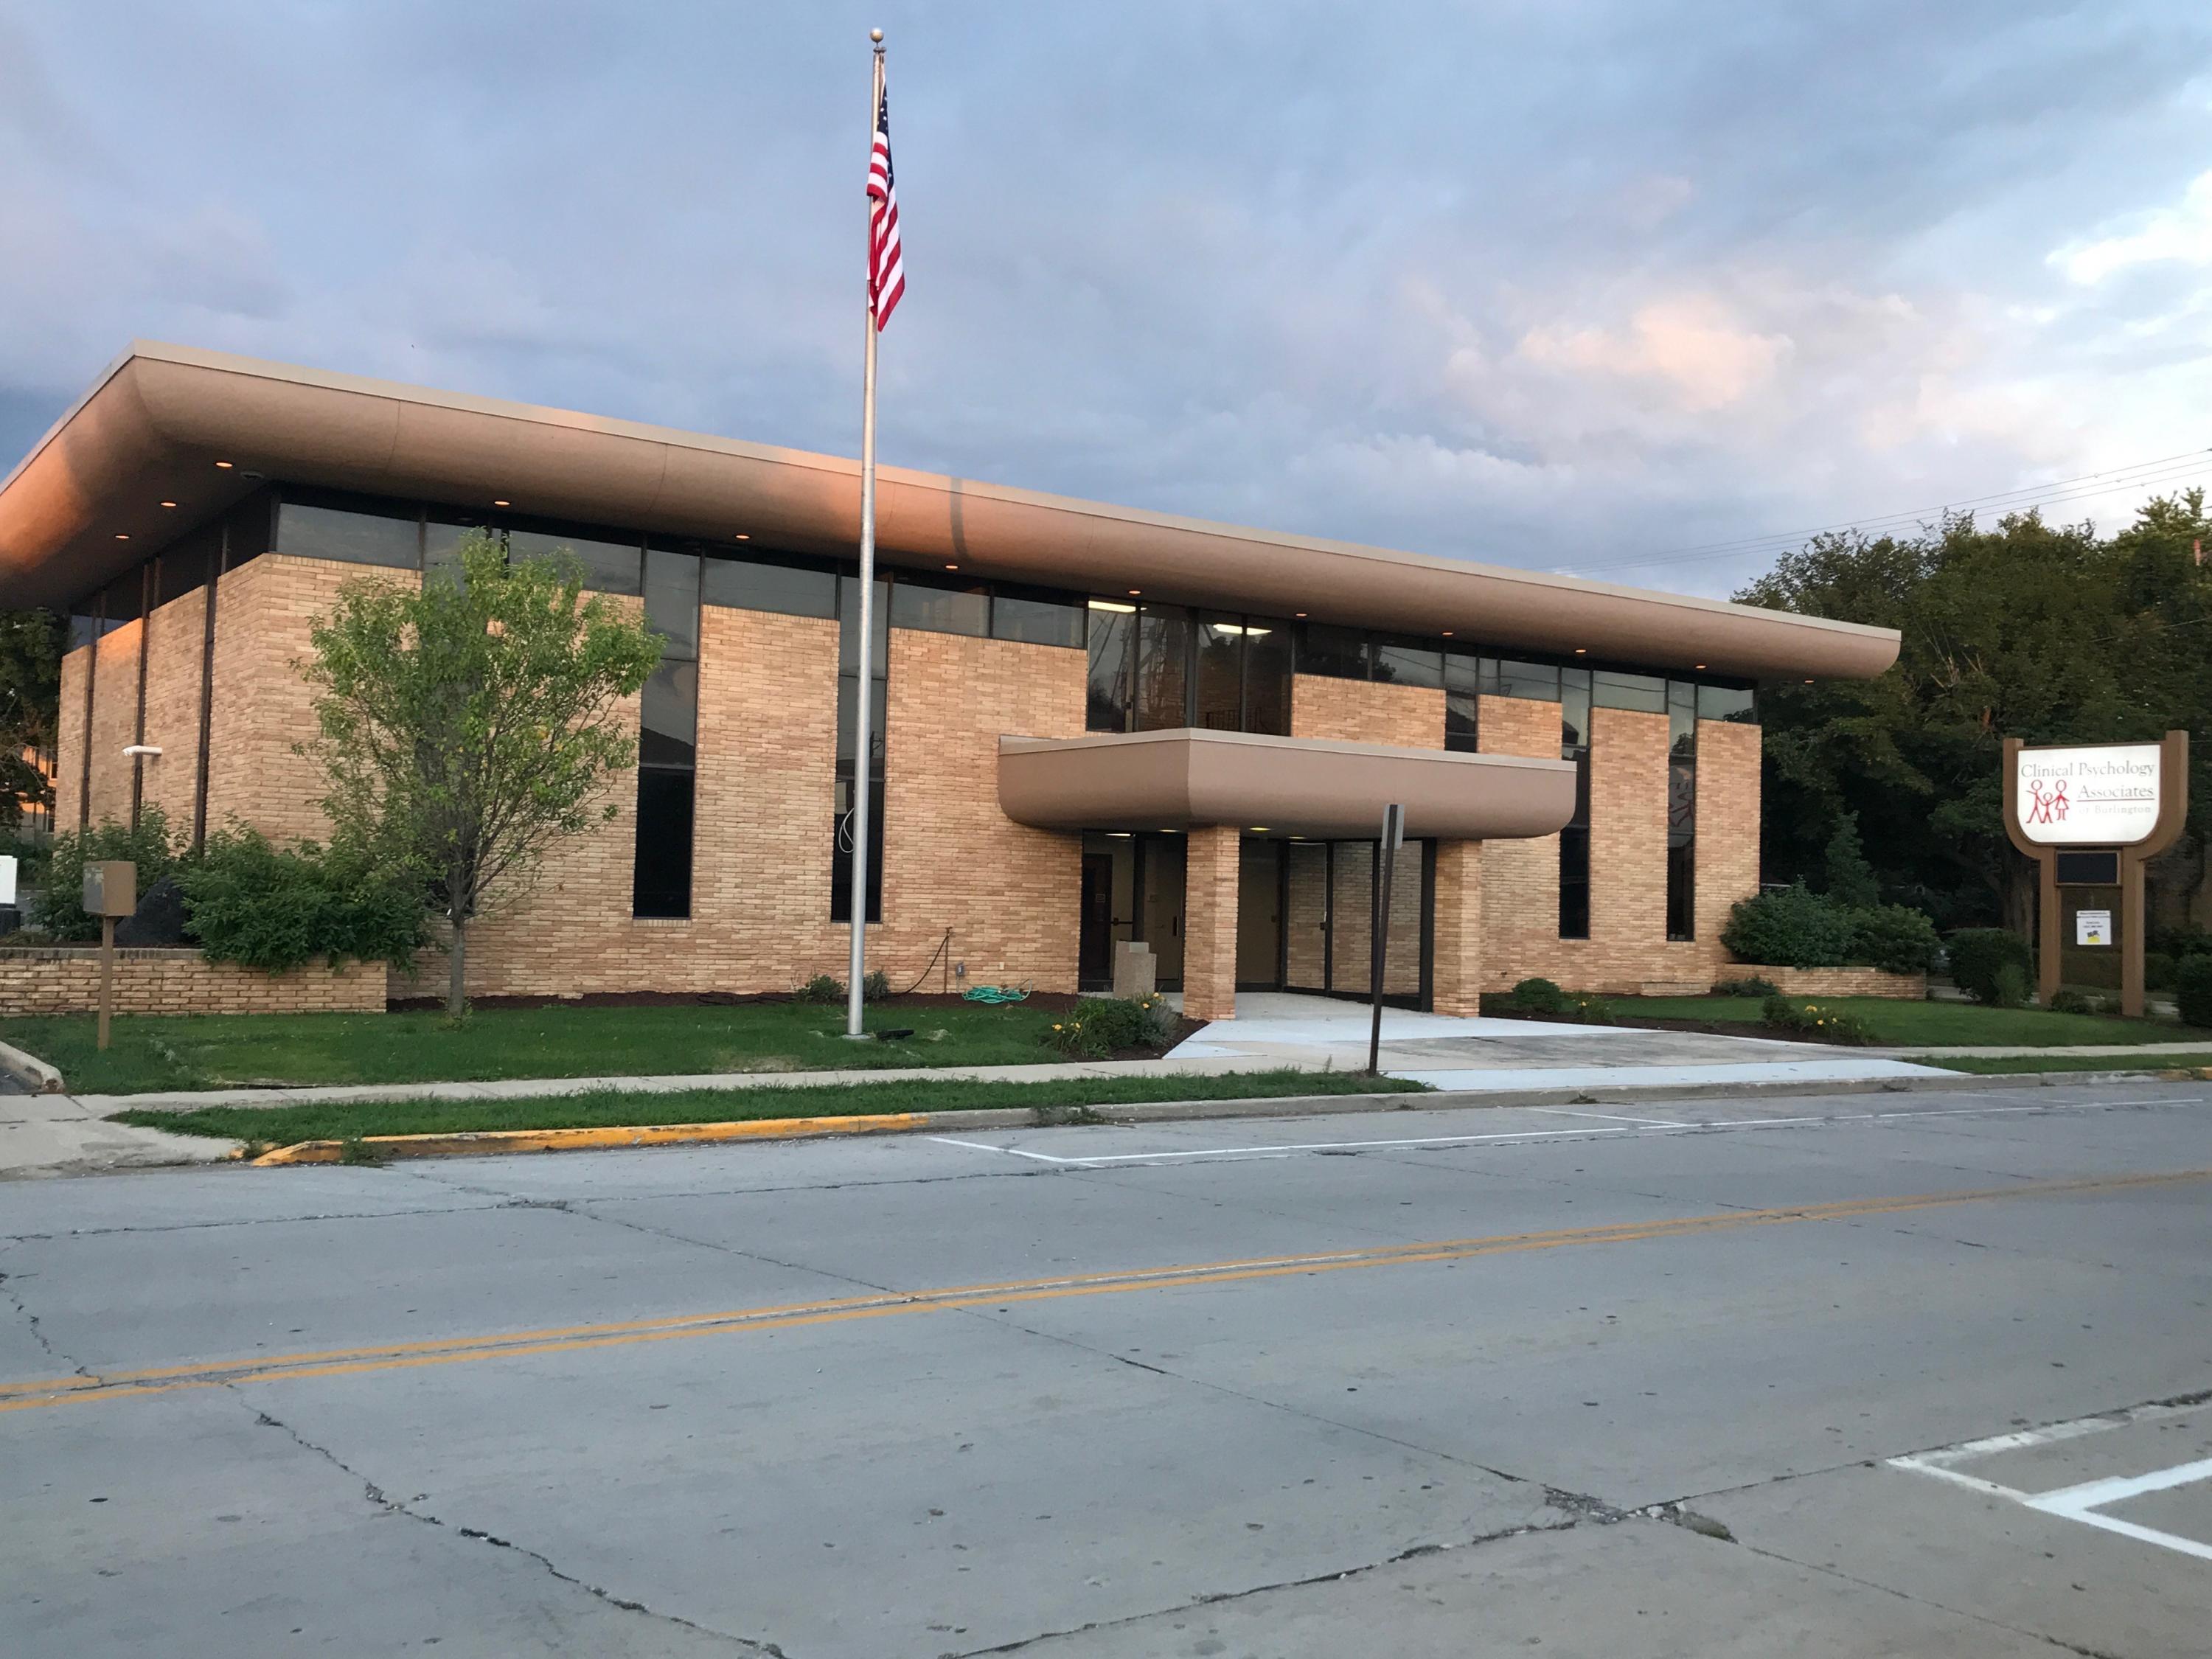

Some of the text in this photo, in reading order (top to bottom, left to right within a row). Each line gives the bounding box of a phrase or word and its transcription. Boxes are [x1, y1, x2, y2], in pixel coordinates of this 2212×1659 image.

[2021, 760, 2155, 778] Clinical Psychology
[2078, 785, 2154, 798] Associates
[2095, 804, 2152, 815] Burlington
